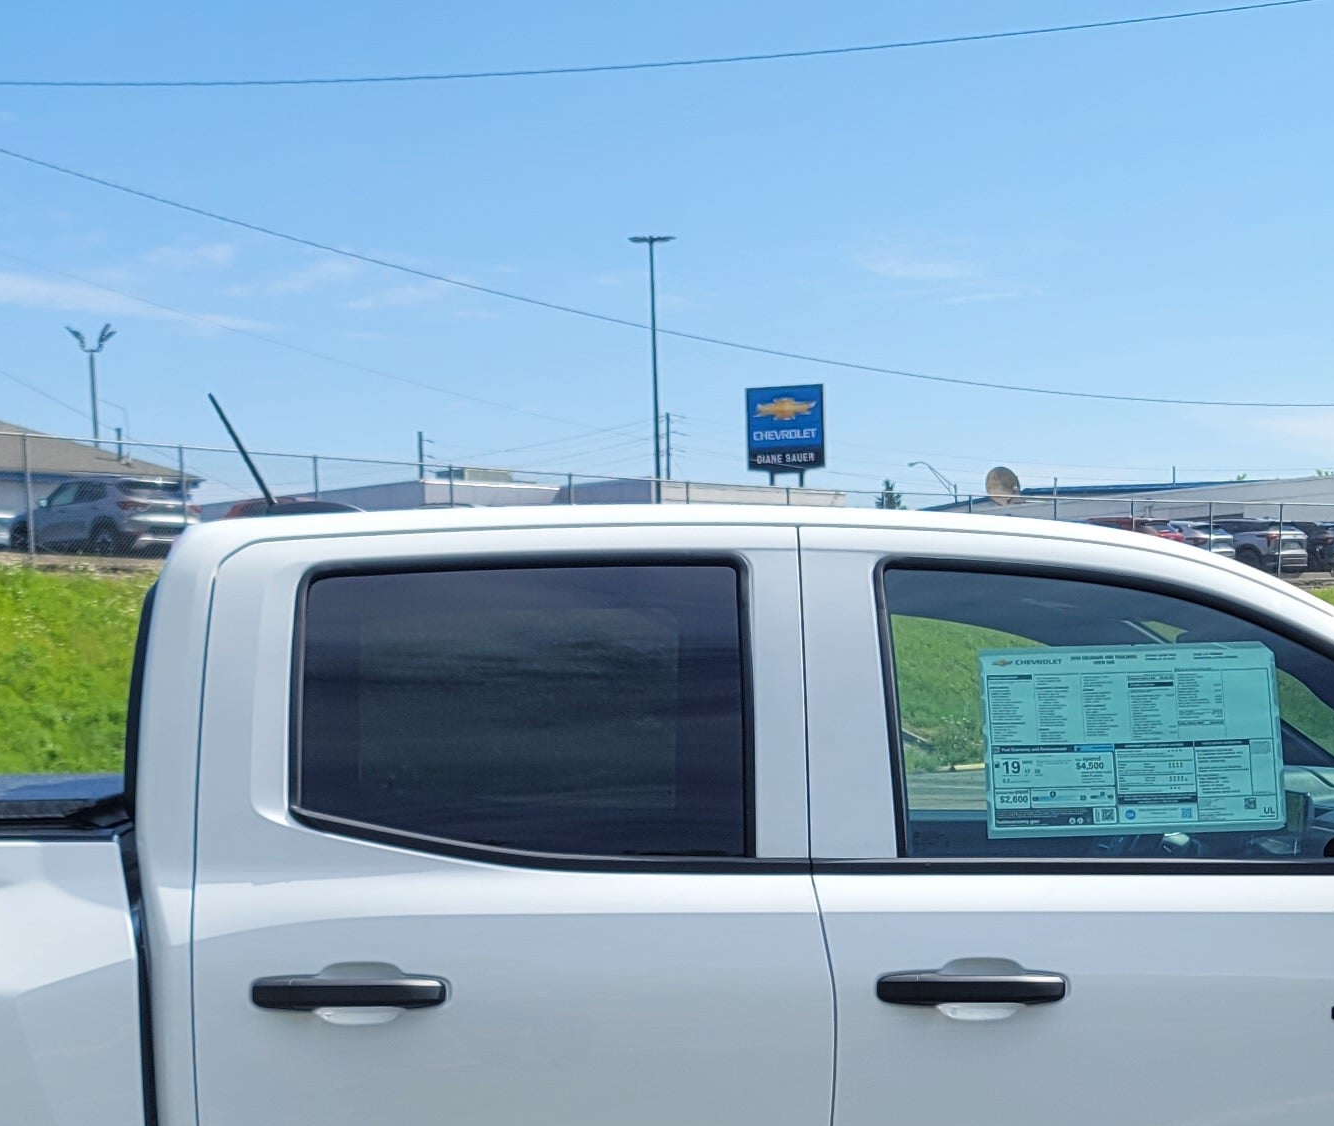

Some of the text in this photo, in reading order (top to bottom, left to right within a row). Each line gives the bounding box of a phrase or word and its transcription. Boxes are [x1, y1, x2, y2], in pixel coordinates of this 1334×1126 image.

[752, 428, 817, 441] CHEVROLET
[756, 452, 815, 465] DIANE SAUER
[1014, 658, 1063, 666] CHEVROLET
[1002, 761, 1021, 774] 19
[1263, 806, 1276, 814] UL
